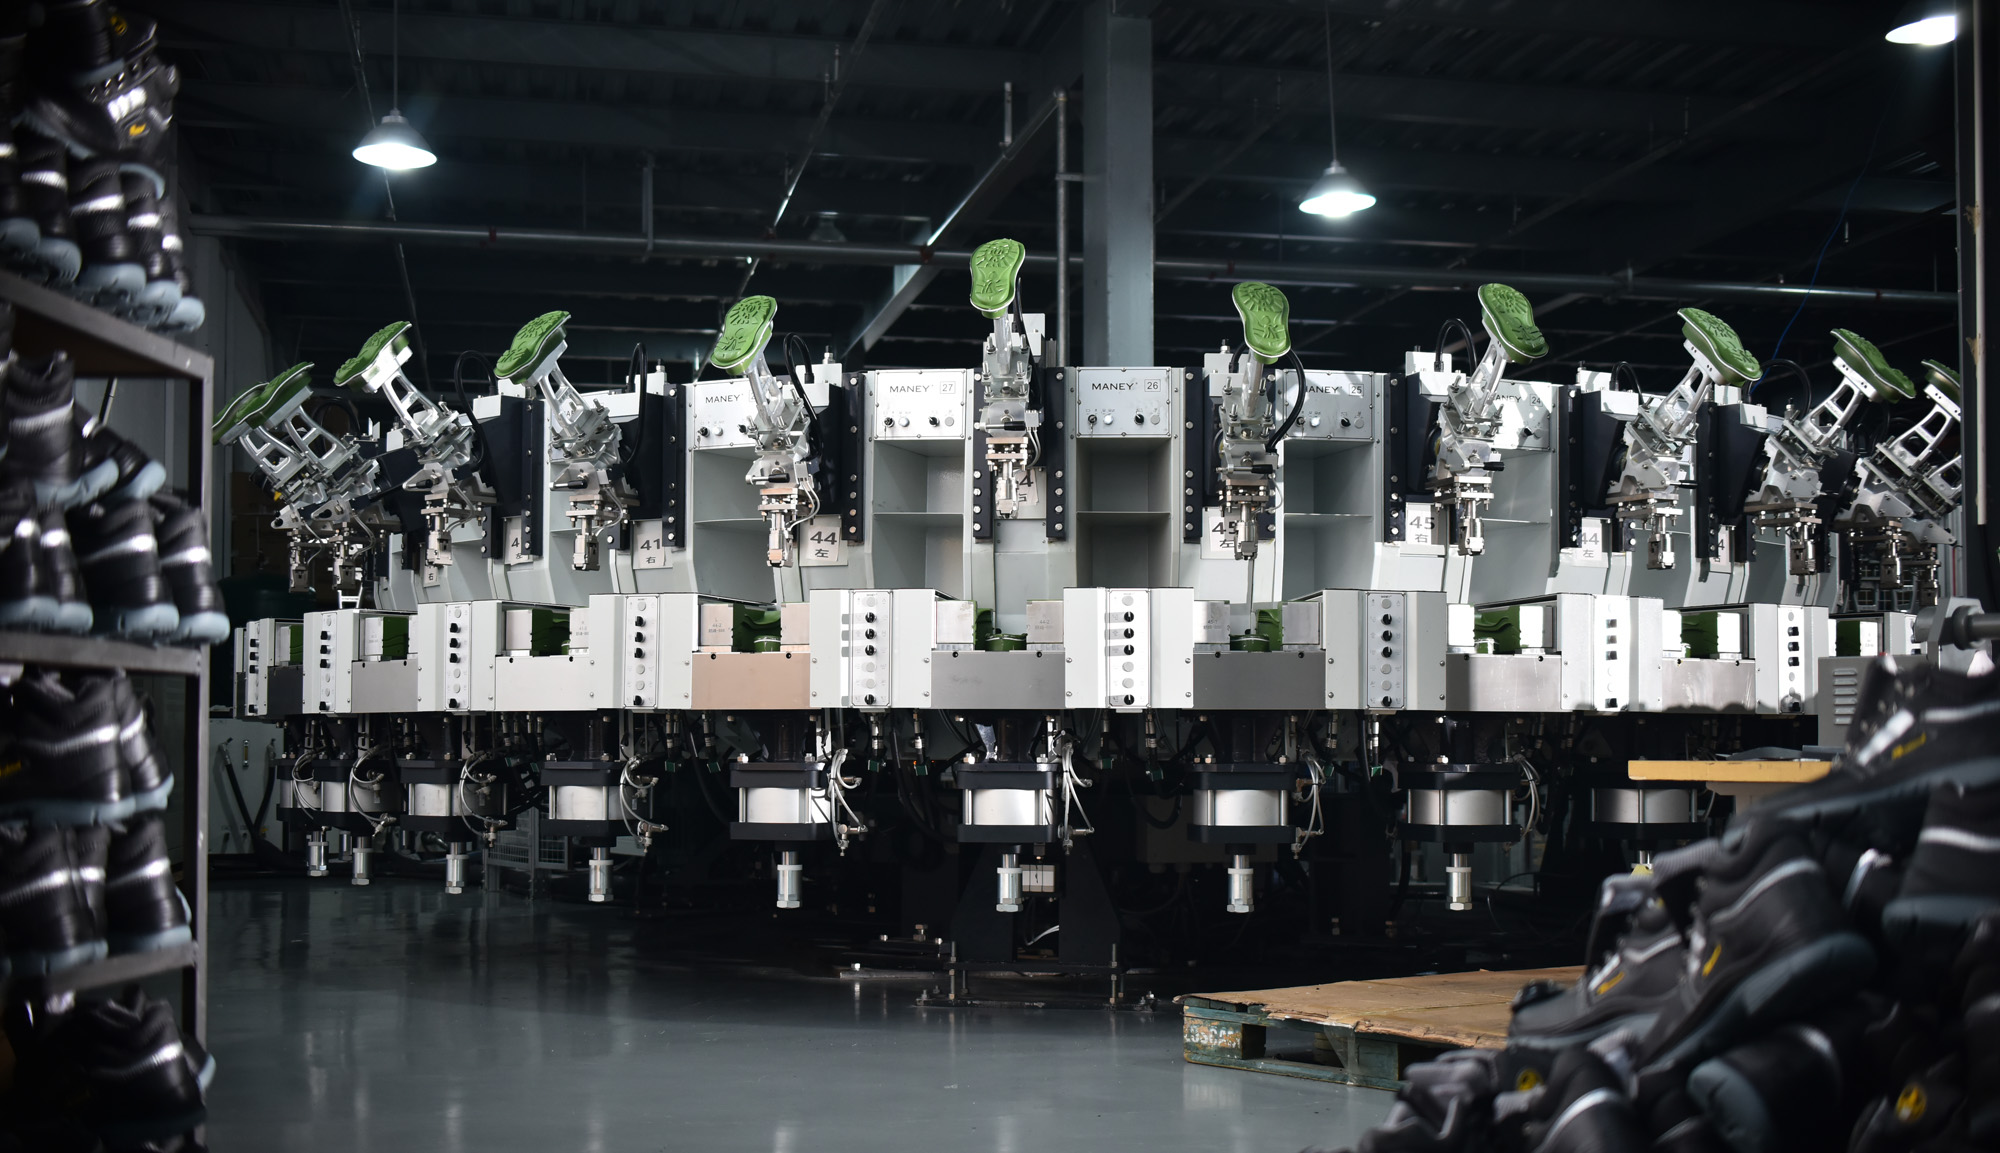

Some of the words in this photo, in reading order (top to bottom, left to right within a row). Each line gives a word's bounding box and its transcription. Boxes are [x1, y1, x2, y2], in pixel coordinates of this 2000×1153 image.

[889, 385, 930, 393] MANEY
[942, 383, 954, 392] 27
[1091, 382, 1134, 391] MANEY
[1146, 381, 1159, 390] 26
[1306, 385, 1339, 394] ANEY
[1351, 385, 1362, 394] 25
[705, 394, 740, 404] MANEY
[1531, 396, 1541, 404] 24
[1211, 521, 1239, 535] 45
[1409, 516, 1435, 530] 45
[810, 531, 837, 545] 44
[1414, 533, 1429, 543] 右
[1582, 532, 1600, 545] 44
[640, 538, 661, 551] 41
[814, 548, 829, 559] 左
[1583, 549, 1595, 559] 左
[645, 556, 657, 564] 右
